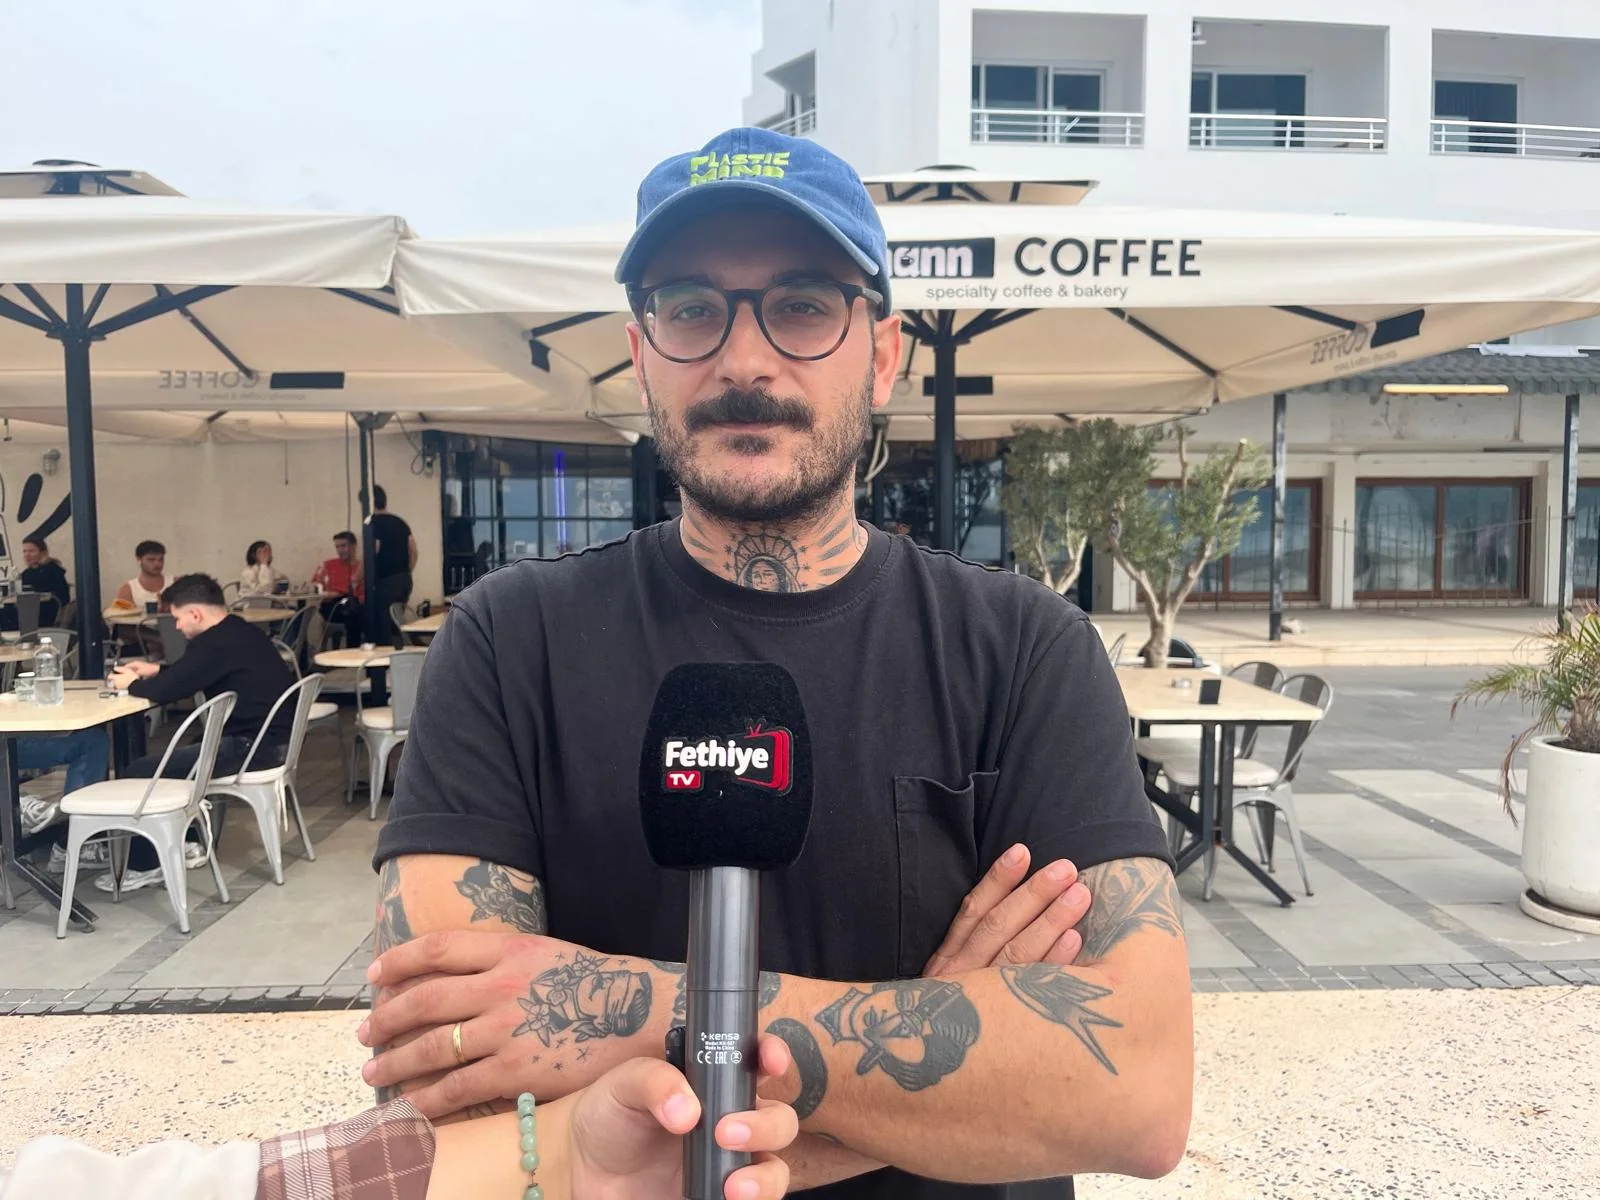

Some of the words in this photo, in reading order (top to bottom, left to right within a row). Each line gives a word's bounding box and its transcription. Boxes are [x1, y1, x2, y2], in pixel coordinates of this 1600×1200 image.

[690, 151, 791, 172] PLASTIC
[1014, 236, 1202, 277] COFFEE
[926, 284, 997, 302] specialty
[1003, 284, 1052, 298] coffee
[1057, 285, 1069, 298] &
[1073, 284, 1129, 300] bakery
[665, 739, 769, 776] Fethiye
[669, 773, 696, 786] TV
[709, 1033, 740, 1041] kensa
